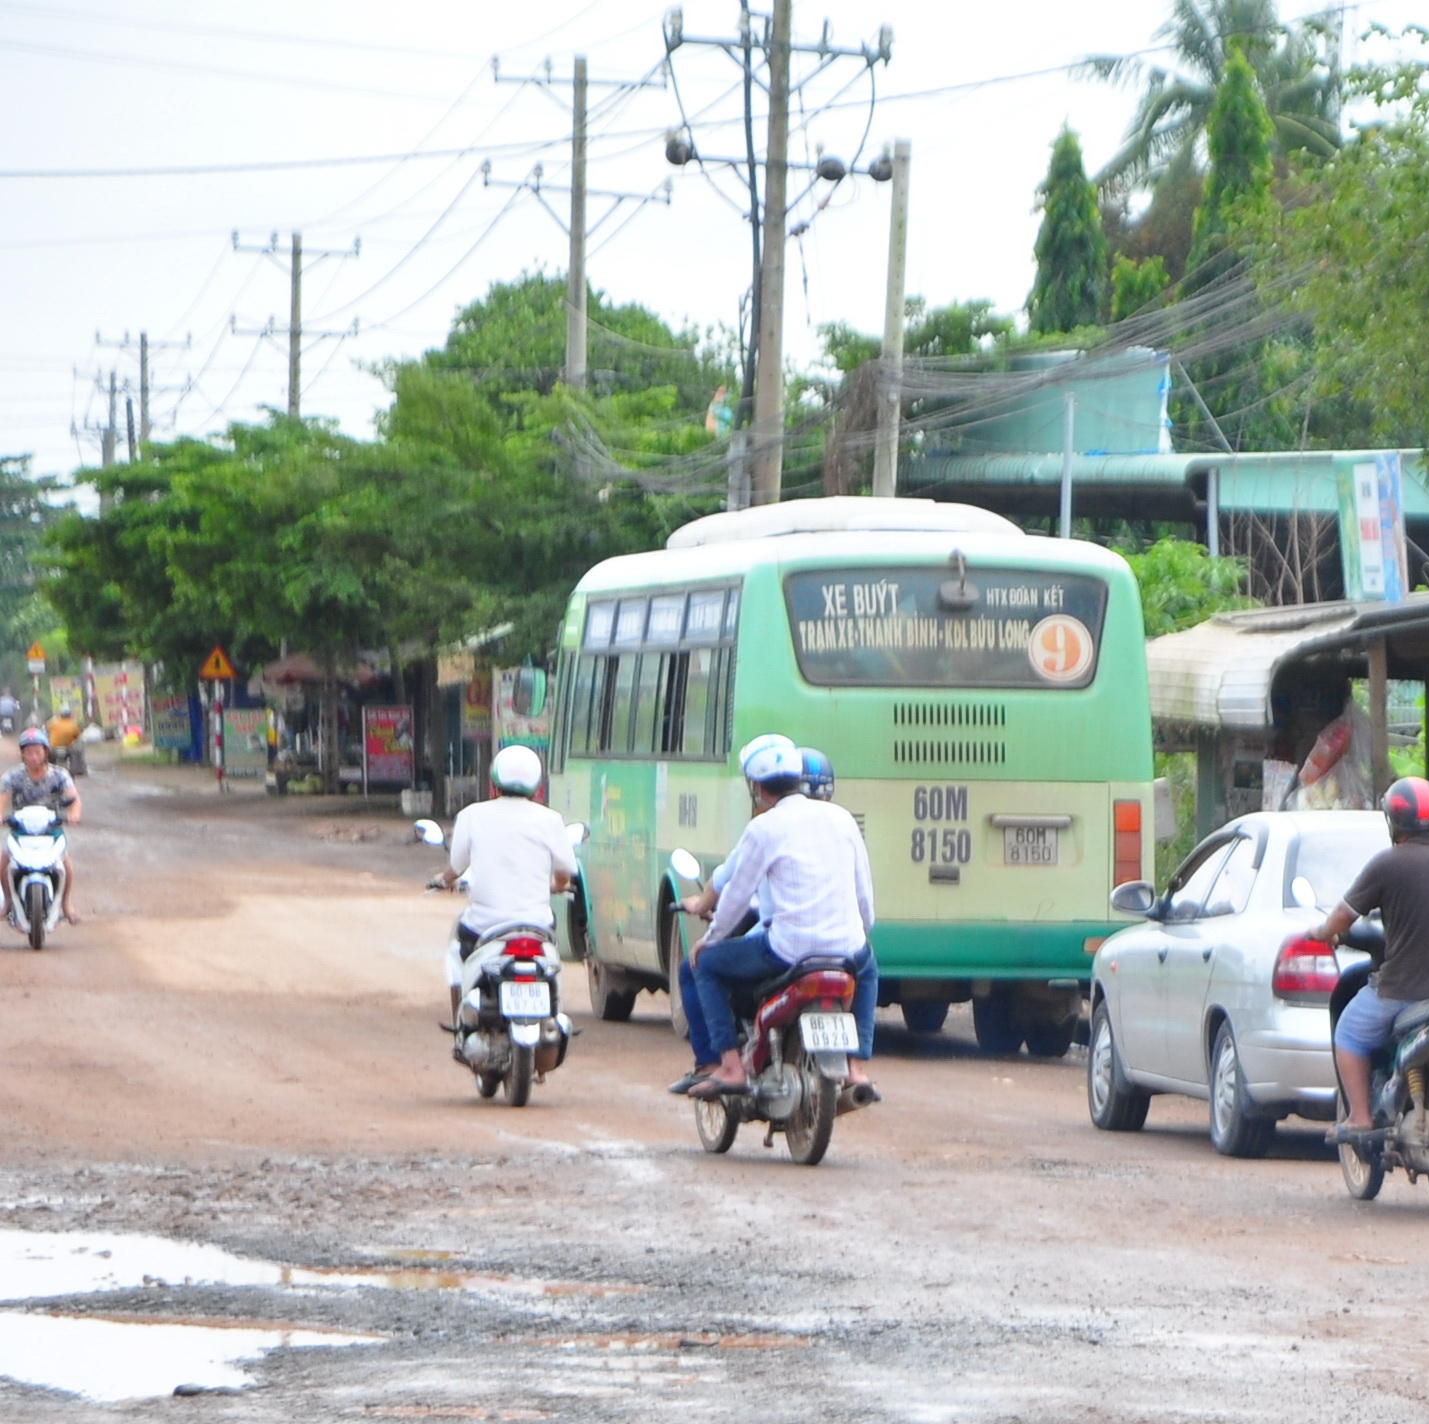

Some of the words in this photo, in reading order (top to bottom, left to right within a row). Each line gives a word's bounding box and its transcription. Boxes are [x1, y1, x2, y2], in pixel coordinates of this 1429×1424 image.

[822, 584, 847, 616] XE
[853, 578, 899, 615] BUÝT
[986, 588, 1008, 606] HTX
[1043, 583, 1065, 607] KẾT
[998, 617, 1030, 650] LONG
[1041, 624, 1082, 673] 9
[914, 785, 968, 821] 60M
[911, 827, 972, 864] 8150
[1015, 826, 1046, 845] 60M
[1010, 845, 1051, 862] 8150
